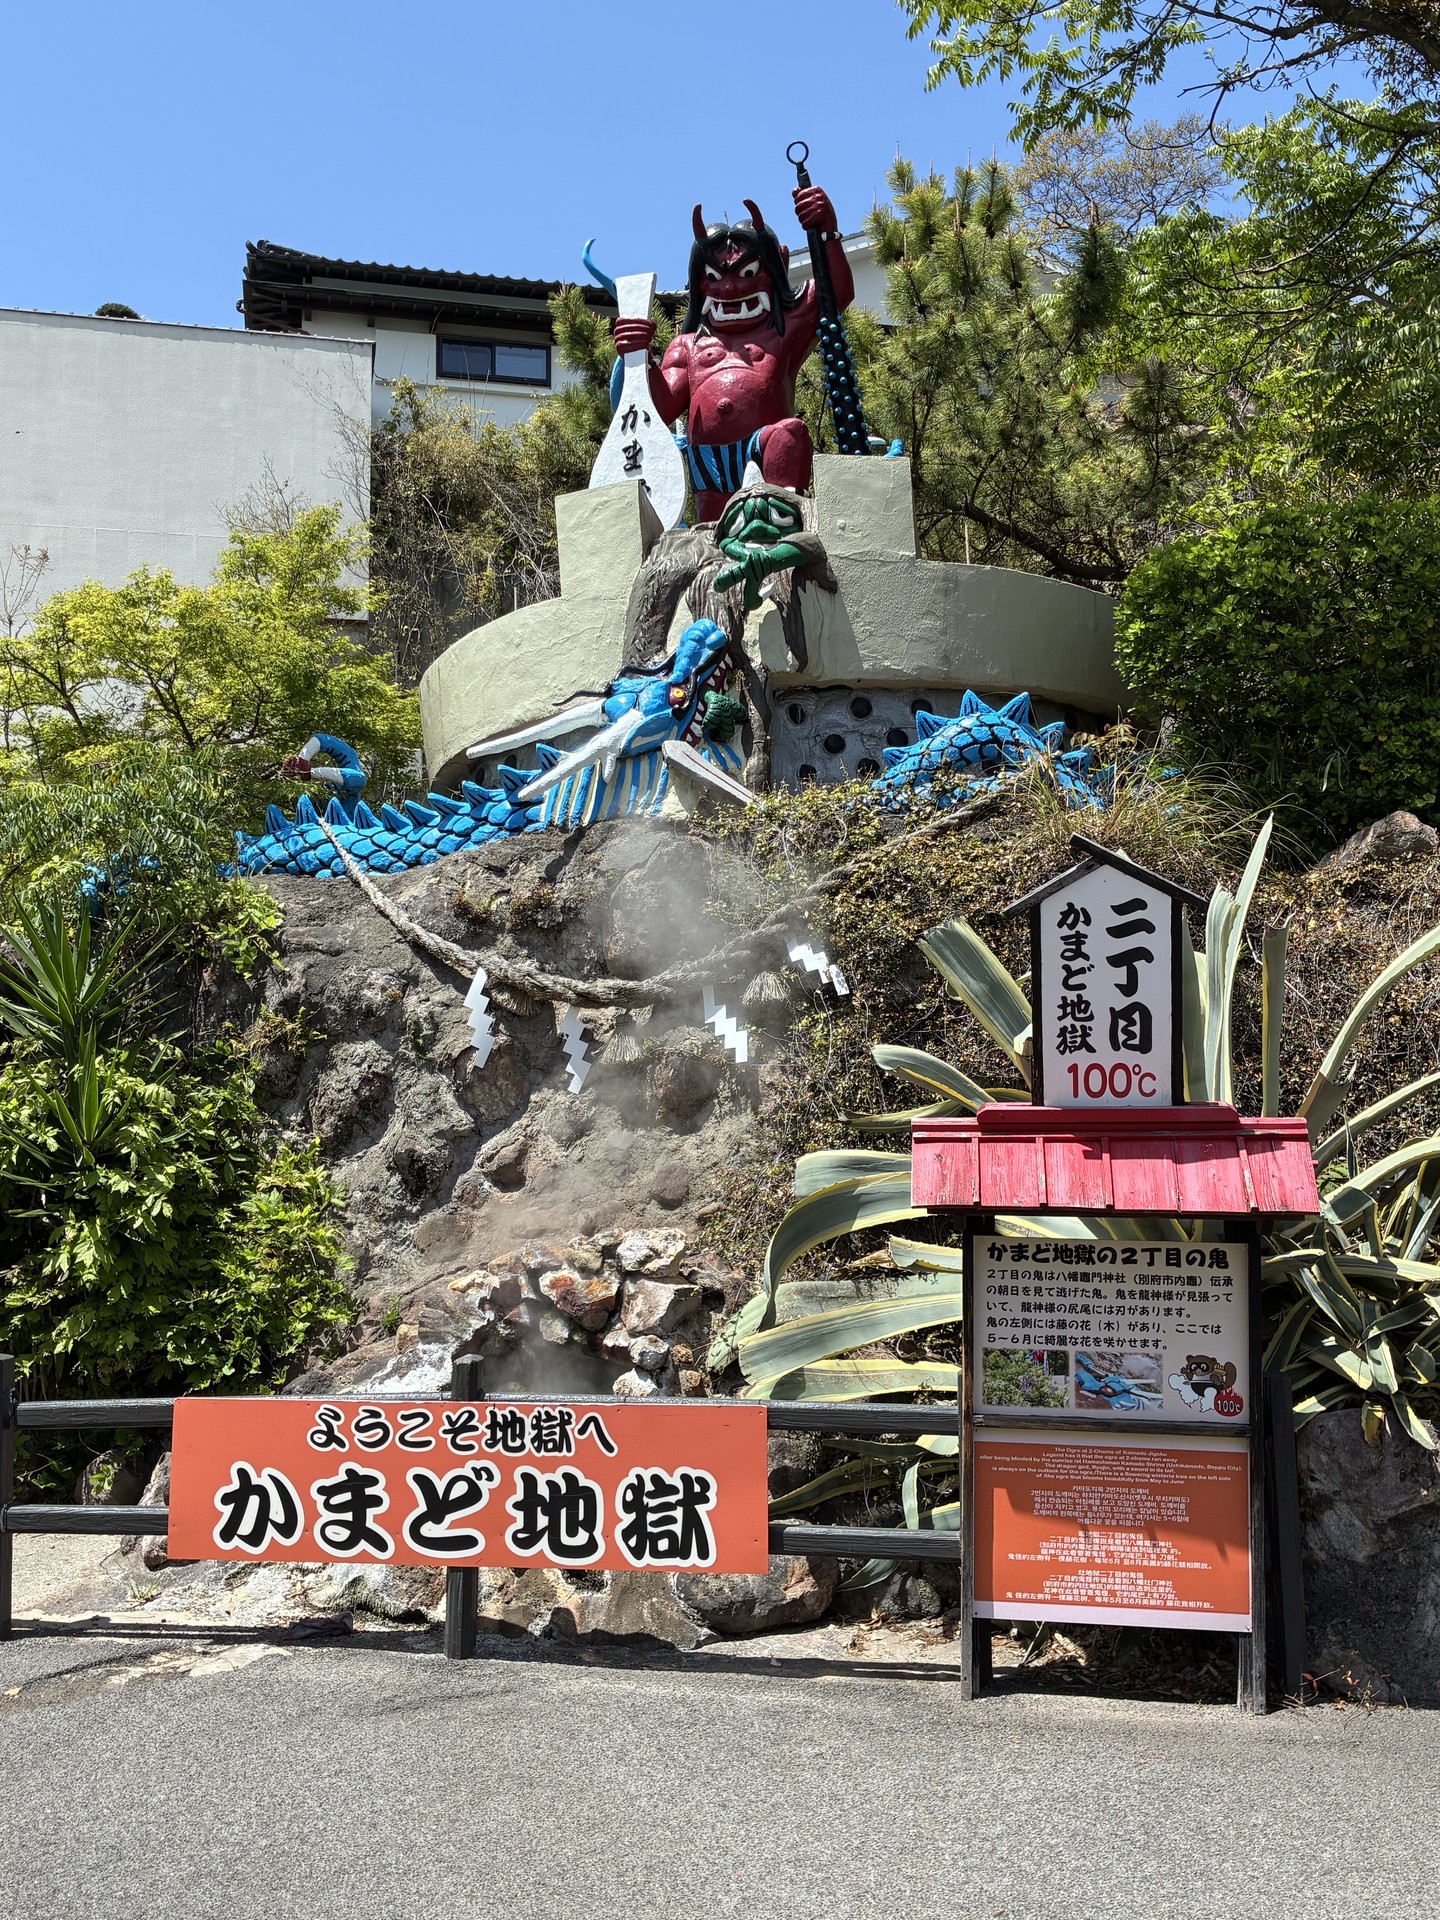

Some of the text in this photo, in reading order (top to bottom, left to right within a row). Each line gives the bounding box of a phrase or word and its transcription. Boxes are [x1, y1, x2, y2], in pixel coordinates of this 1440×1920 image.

[620, 403, 651, 493] かま
[1055, 901, 1097, 1056] かまど地獄
[1105, 897, 1156, 1055] 二丁目
[987, 1241, 1230, 1270] かまど地獄の2丁目の鬼
[986, 1301, 1192, 1319] いて、龍神様の尻尾には刃があります。
[308, 1405, 617, 1456] ようこそ地獄へ
[216, 1462, 716, 1565] かまど地獄
